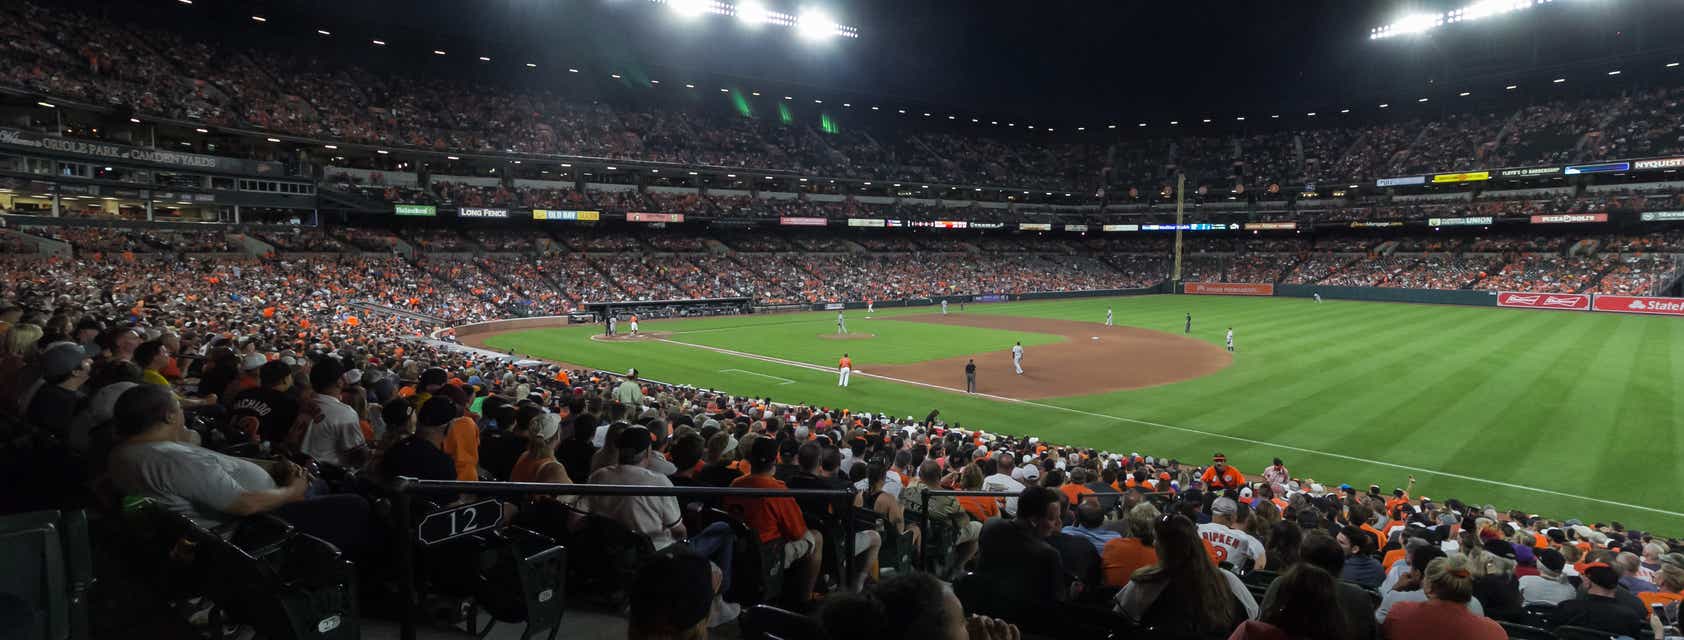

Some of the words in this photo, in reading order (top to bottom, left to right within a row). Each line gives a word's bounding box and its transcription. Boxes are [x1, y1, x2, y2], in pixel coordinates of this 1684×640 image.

[43, 138, 88, 154] ORIOLE
[88, 144, 120, 157] PARK
[130, 149, 176, 164] CAMDEN
[176, 155, 216, 167] YARDS
[1634, 159, 1681, 169] NYQUIST
[461, 208, 482, 217] LONG
[483, 209, 507, 217] FENCE
[547, 211, 562, 219] OLD
[562, 211, 577, 220] BAY
[1466, 217, 1492, 225] UNION
[449, 508, 478, 535] 12
[1202, 532, 1240, 549] RIPKEN
